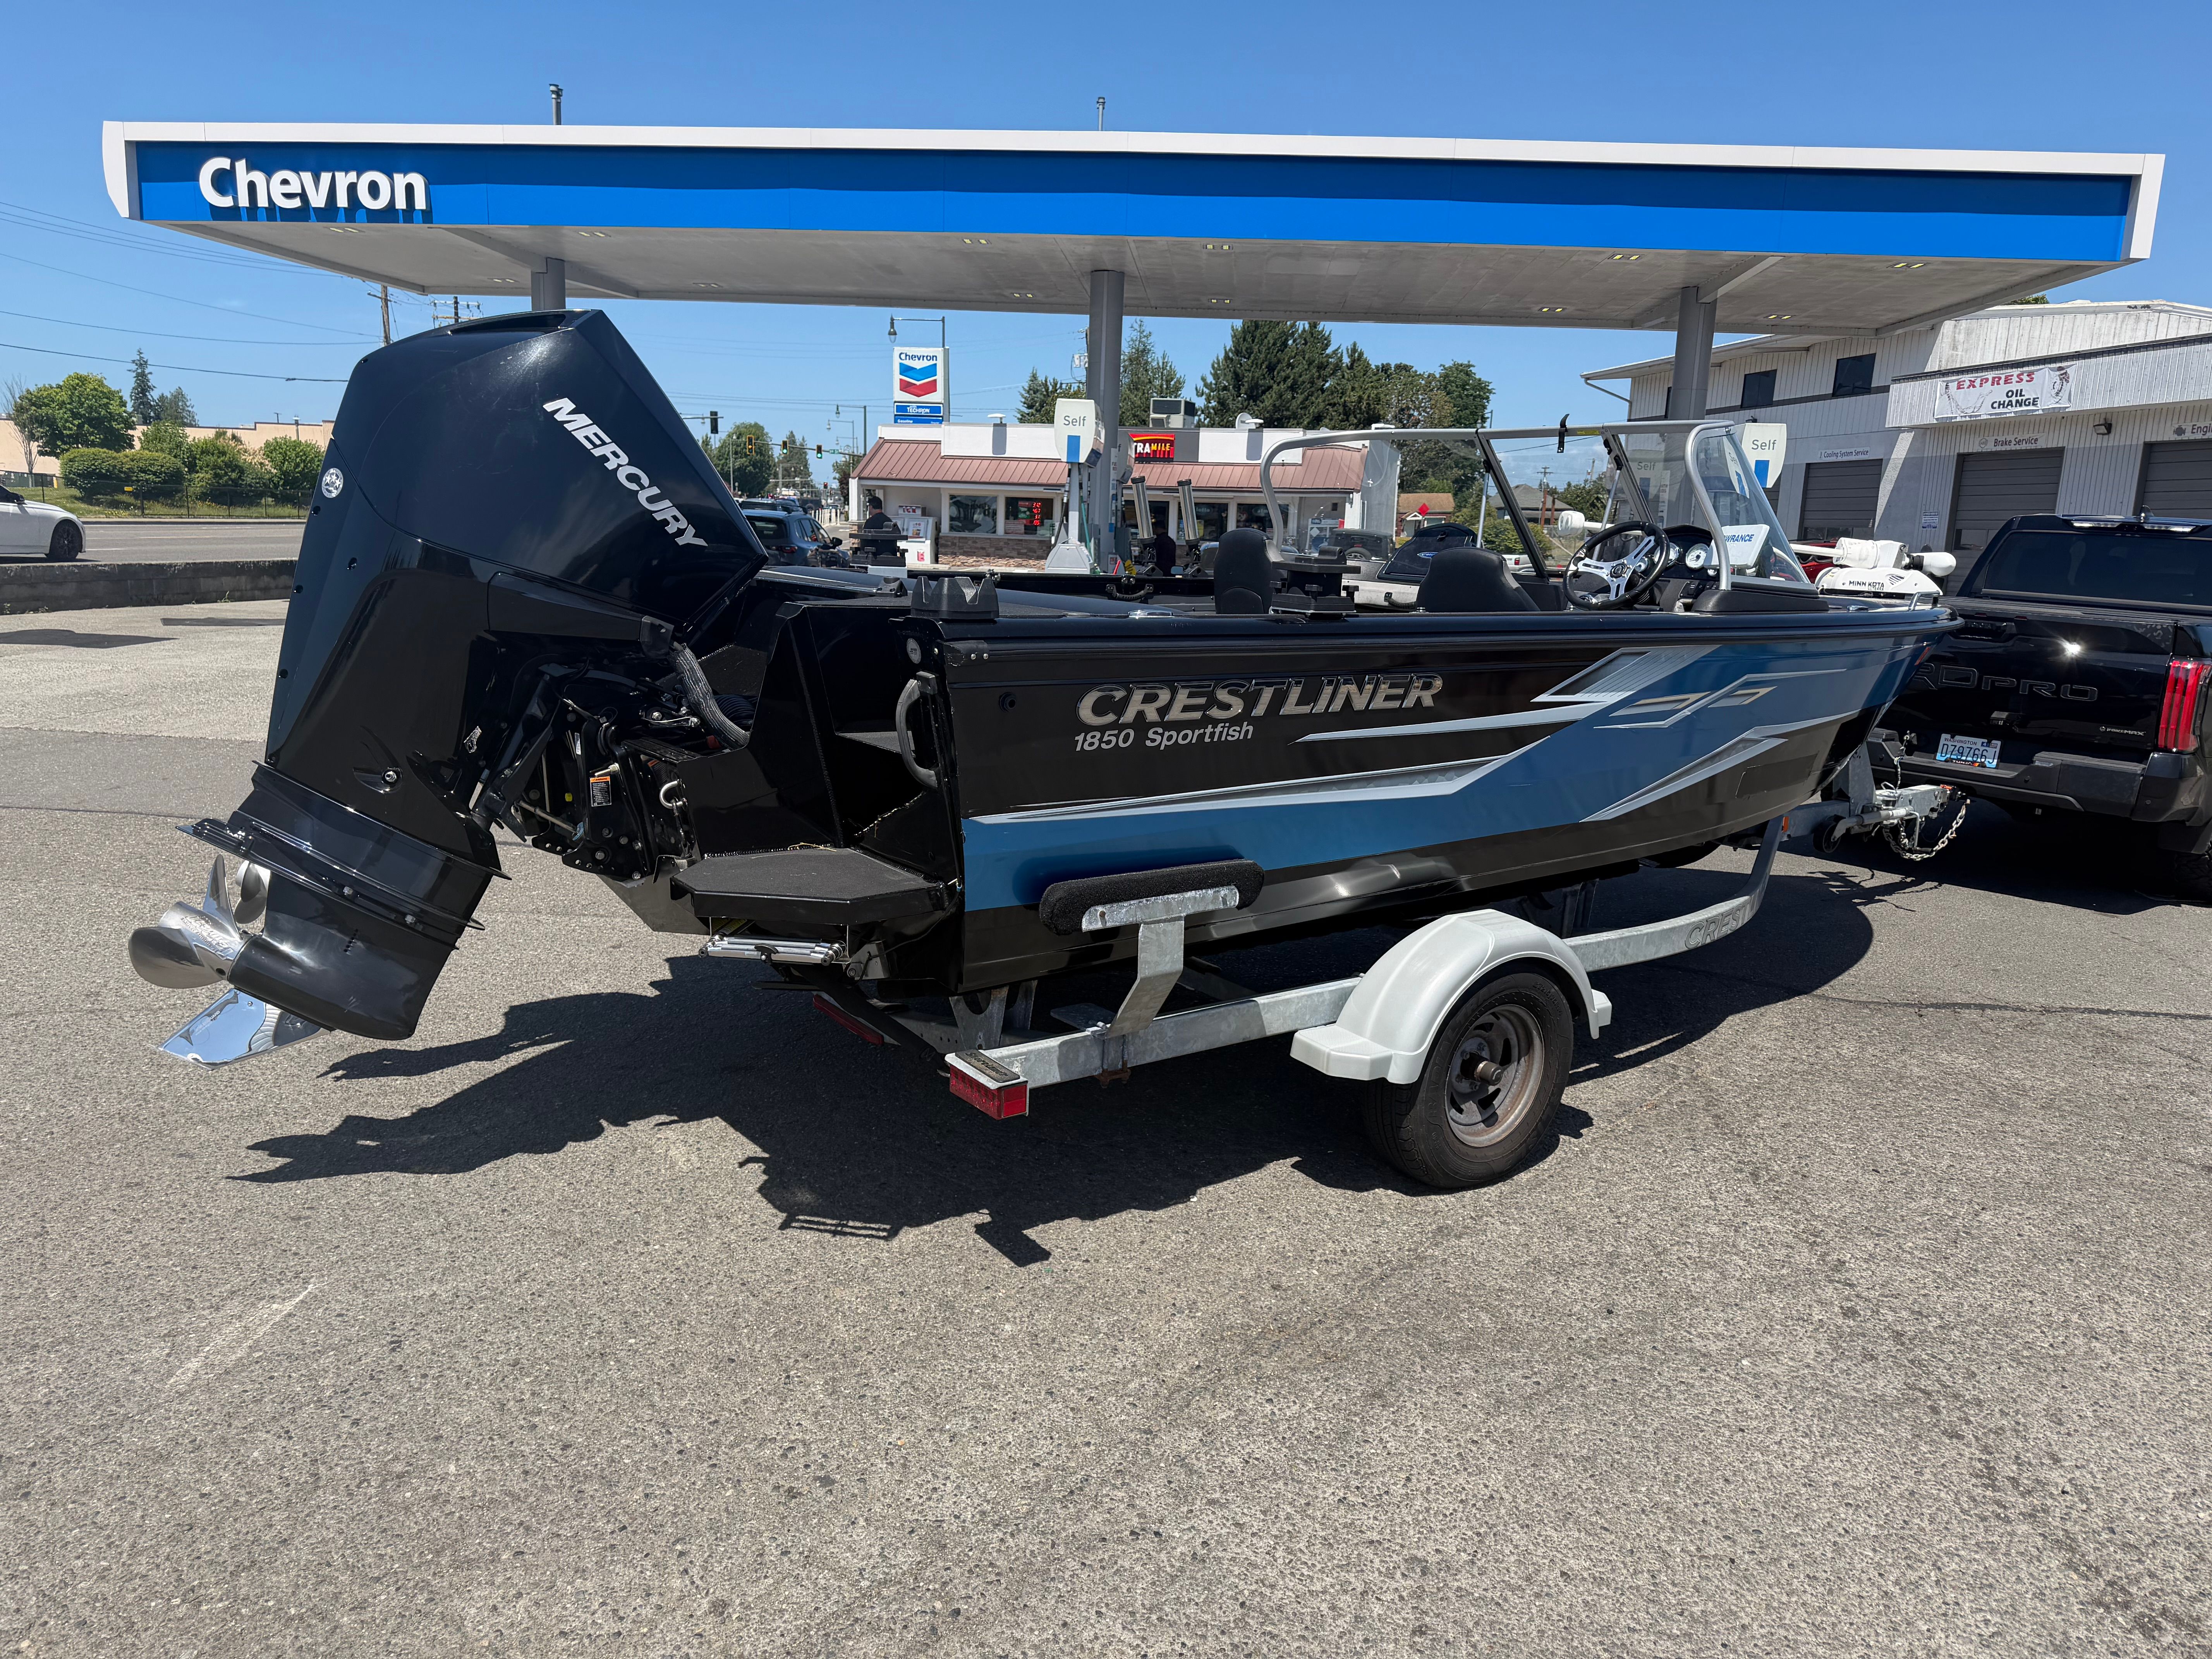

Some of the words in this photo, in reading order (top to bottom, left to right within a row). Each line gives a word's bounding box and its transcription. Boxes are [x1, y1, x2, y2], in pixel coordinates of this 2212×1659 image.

[199, 156, 428, 210] Chevron
[899, 352, 937, 361] Chevron
[1956, 372, 2035, 390] EXPRESS
[2006, 388, 2025, 398] OIL
[1990, 397, 2039, 409] CHANGE
[1063, 415, 1087, 426] Self
[2191, 423, 2212, 436] Engi
[1751, 440, 1777, 450] Self
[1994, 438, 2012, 447] Brake
[2013, 437, 2038, 445] Service
[543, 397, 708, 546] MERCURY
[1637, 462, 1656, 471] Self
[1724, 534, 1754, 542] WRANCE
[1913, 663, 1978, 690] RD
[1076, 672, 1443, 726] CRESTLINER
[1074, 728, 1134, 751] 1850
[1146, 721, 1254, 750] Sportfish
[1944, 737, 1977, 746] WASHINGTON
[1940, 743, 1997, 764] D79766J
